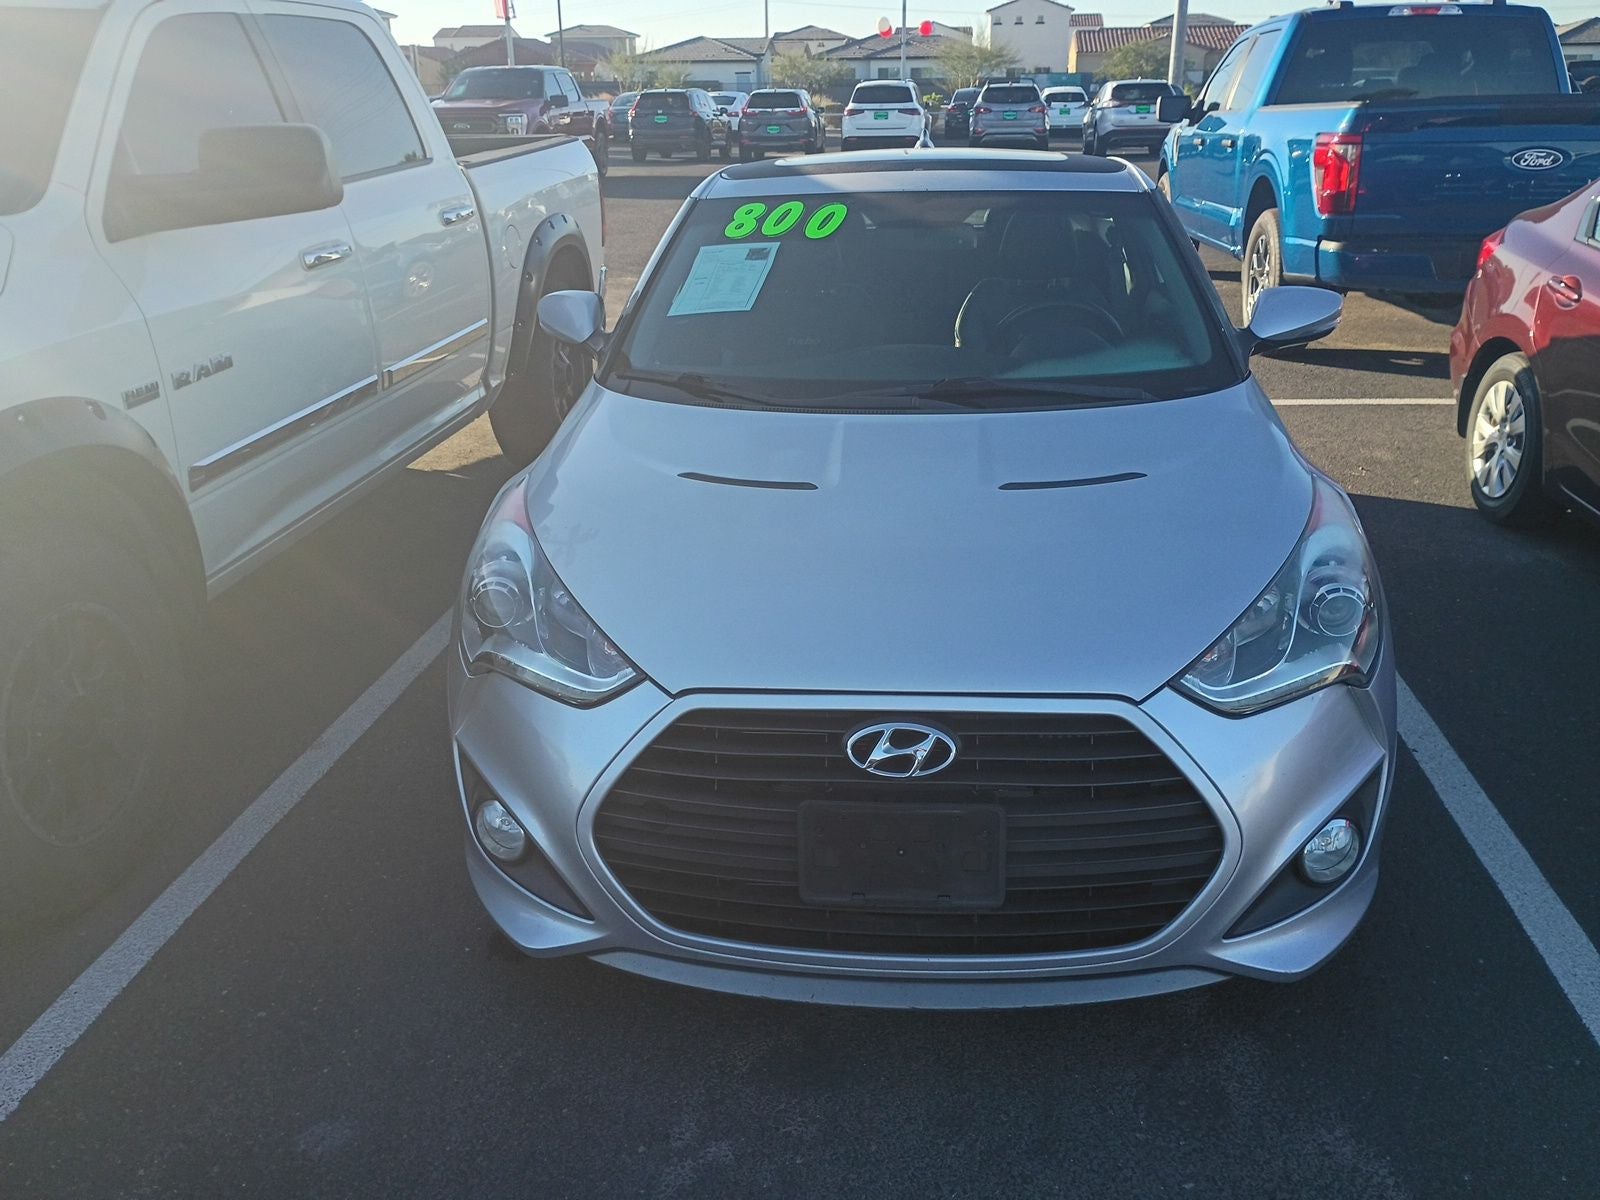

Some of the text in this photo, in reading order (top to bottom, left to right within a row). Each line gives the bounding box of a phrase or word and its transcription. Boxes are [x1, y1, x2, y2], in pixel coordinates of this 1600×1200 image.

[1520, 152, 1554, 166] Ford
[724, 200, 848, 239] 800
[170, 353, 234, 391] RAM
